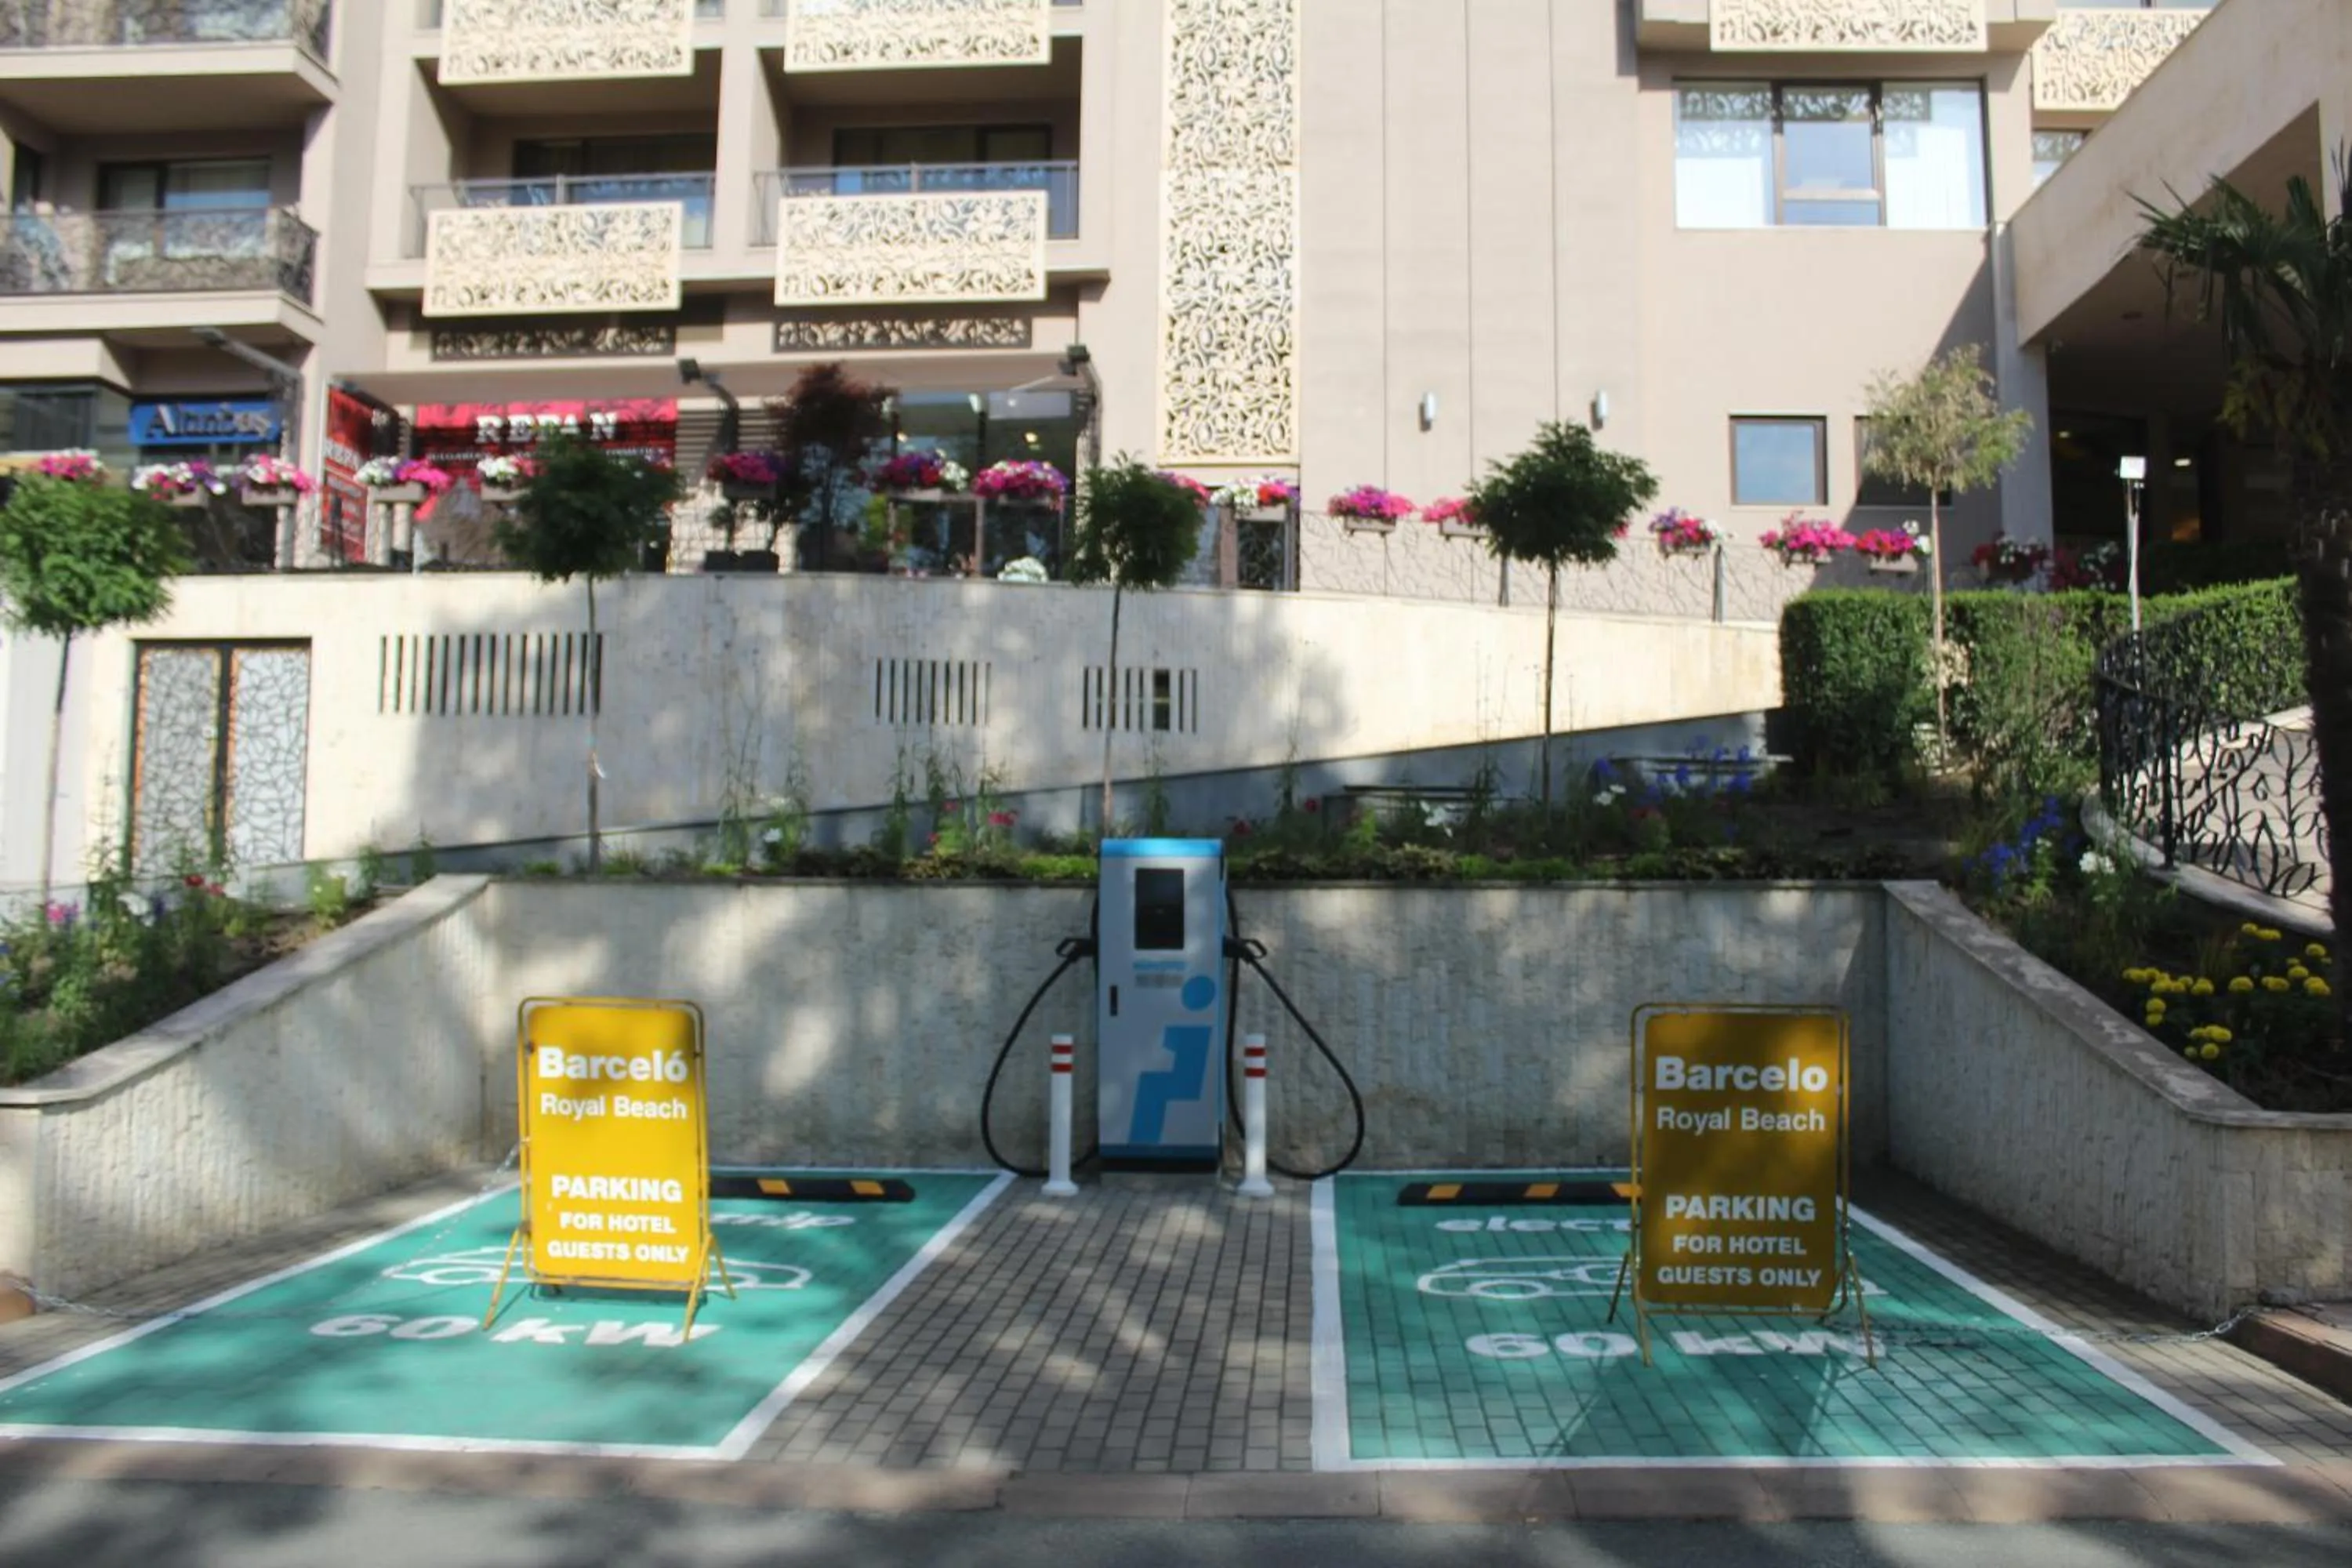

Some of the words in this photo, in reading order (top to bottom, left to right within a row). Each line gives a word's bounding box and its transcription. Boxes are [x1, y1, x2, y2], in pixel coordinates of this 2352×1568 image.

[538, 1046, 688, 1083] Barceló
[1655, 1055, 1829, 1093] Barcelo
[540, 1092, 606, 1121] Royal
[613, 1095, 688, 1120] Beach
[1657, 1106, 1730, 1136] Royal
[1740, 1107, 1826, 1131] Beach
[551, 1175, 682, 1203] PARKING
[1665, 1195, 1817, 1221] PARKING
[559, 1211, 604, 1230] FOR
[608, 1214, 677, 1234] HOTEL
[546, 1240, 630, 1261] GUESTS
[634, 1244, 691, 1264] ONLY
[1672, 1234, 1722, 1254] FOR
[1729, 1236, 1807, 1255] HOTEL
[1657, 1265, 1753, 1286] GUESTS
[1759, 1267, 1822, 1288] ONLY
[309, 1314, 481, 1340] 60
[489, 1318, 723, 1347] kW
[1465, 1332, 1639, 1359] 60
